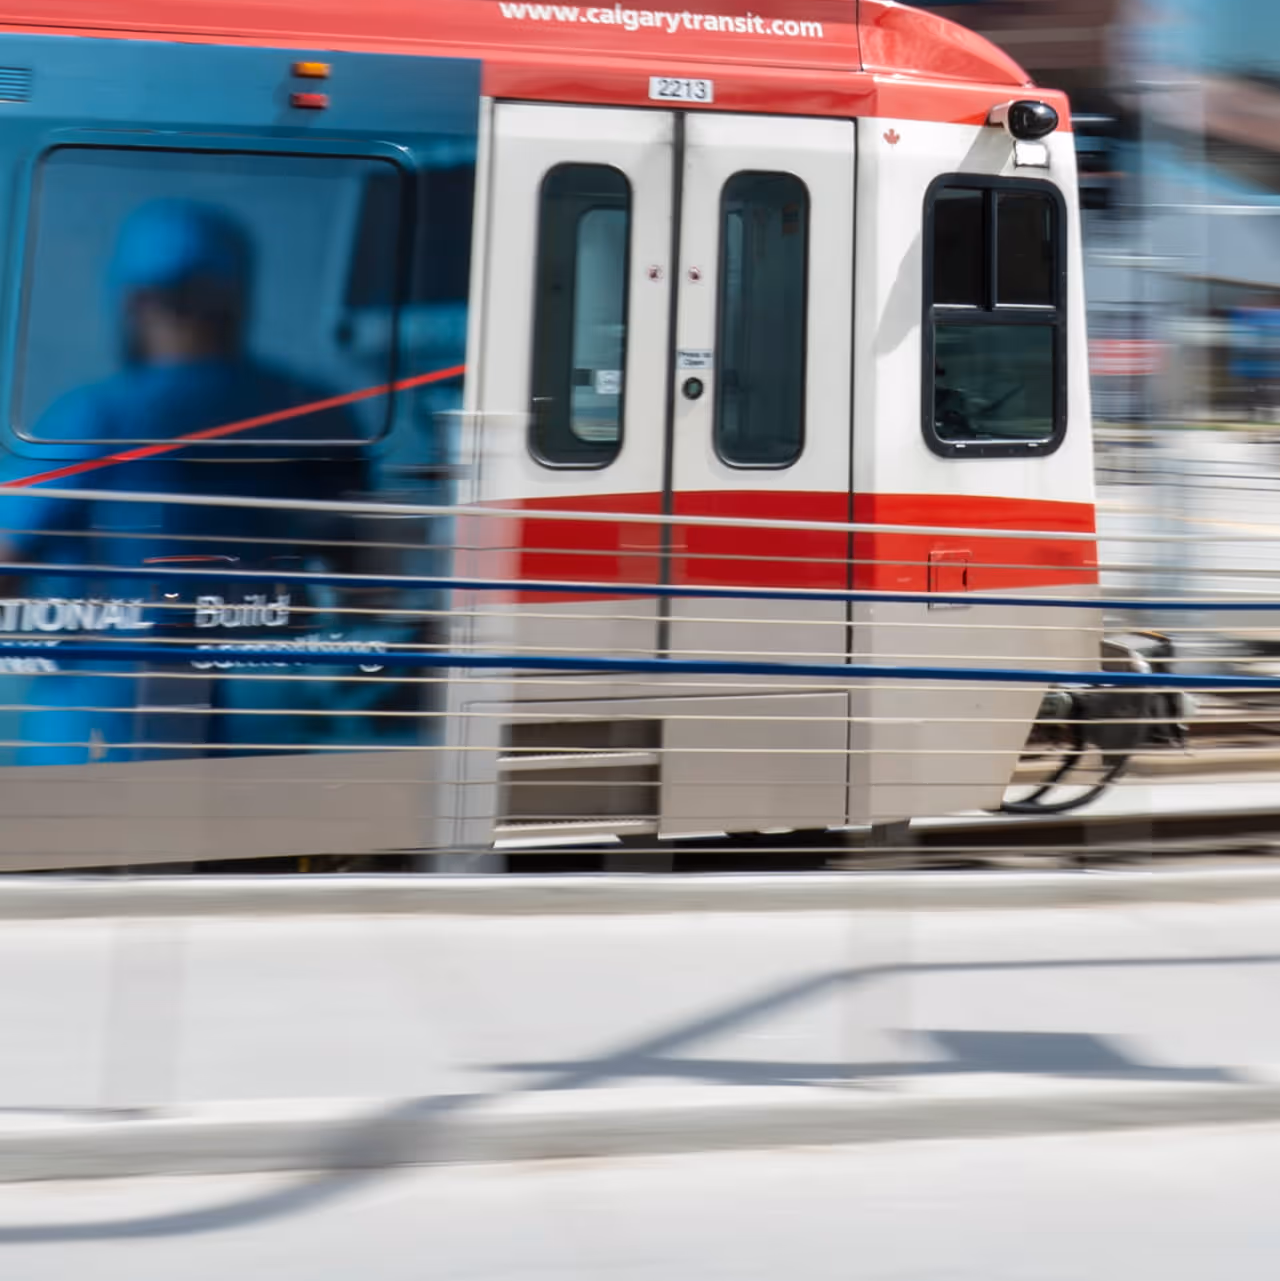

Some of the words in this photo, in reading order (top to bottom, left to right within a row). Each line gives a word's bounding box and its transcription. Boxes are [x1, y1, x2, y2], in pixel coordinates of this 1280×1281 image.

[498, 2, 823, 38] www.calgarytransit.com
[658, 79, 705, 99] 2213
[0, 598, 154, 632] TIONAL
[195, 594, 290, 628] Build
